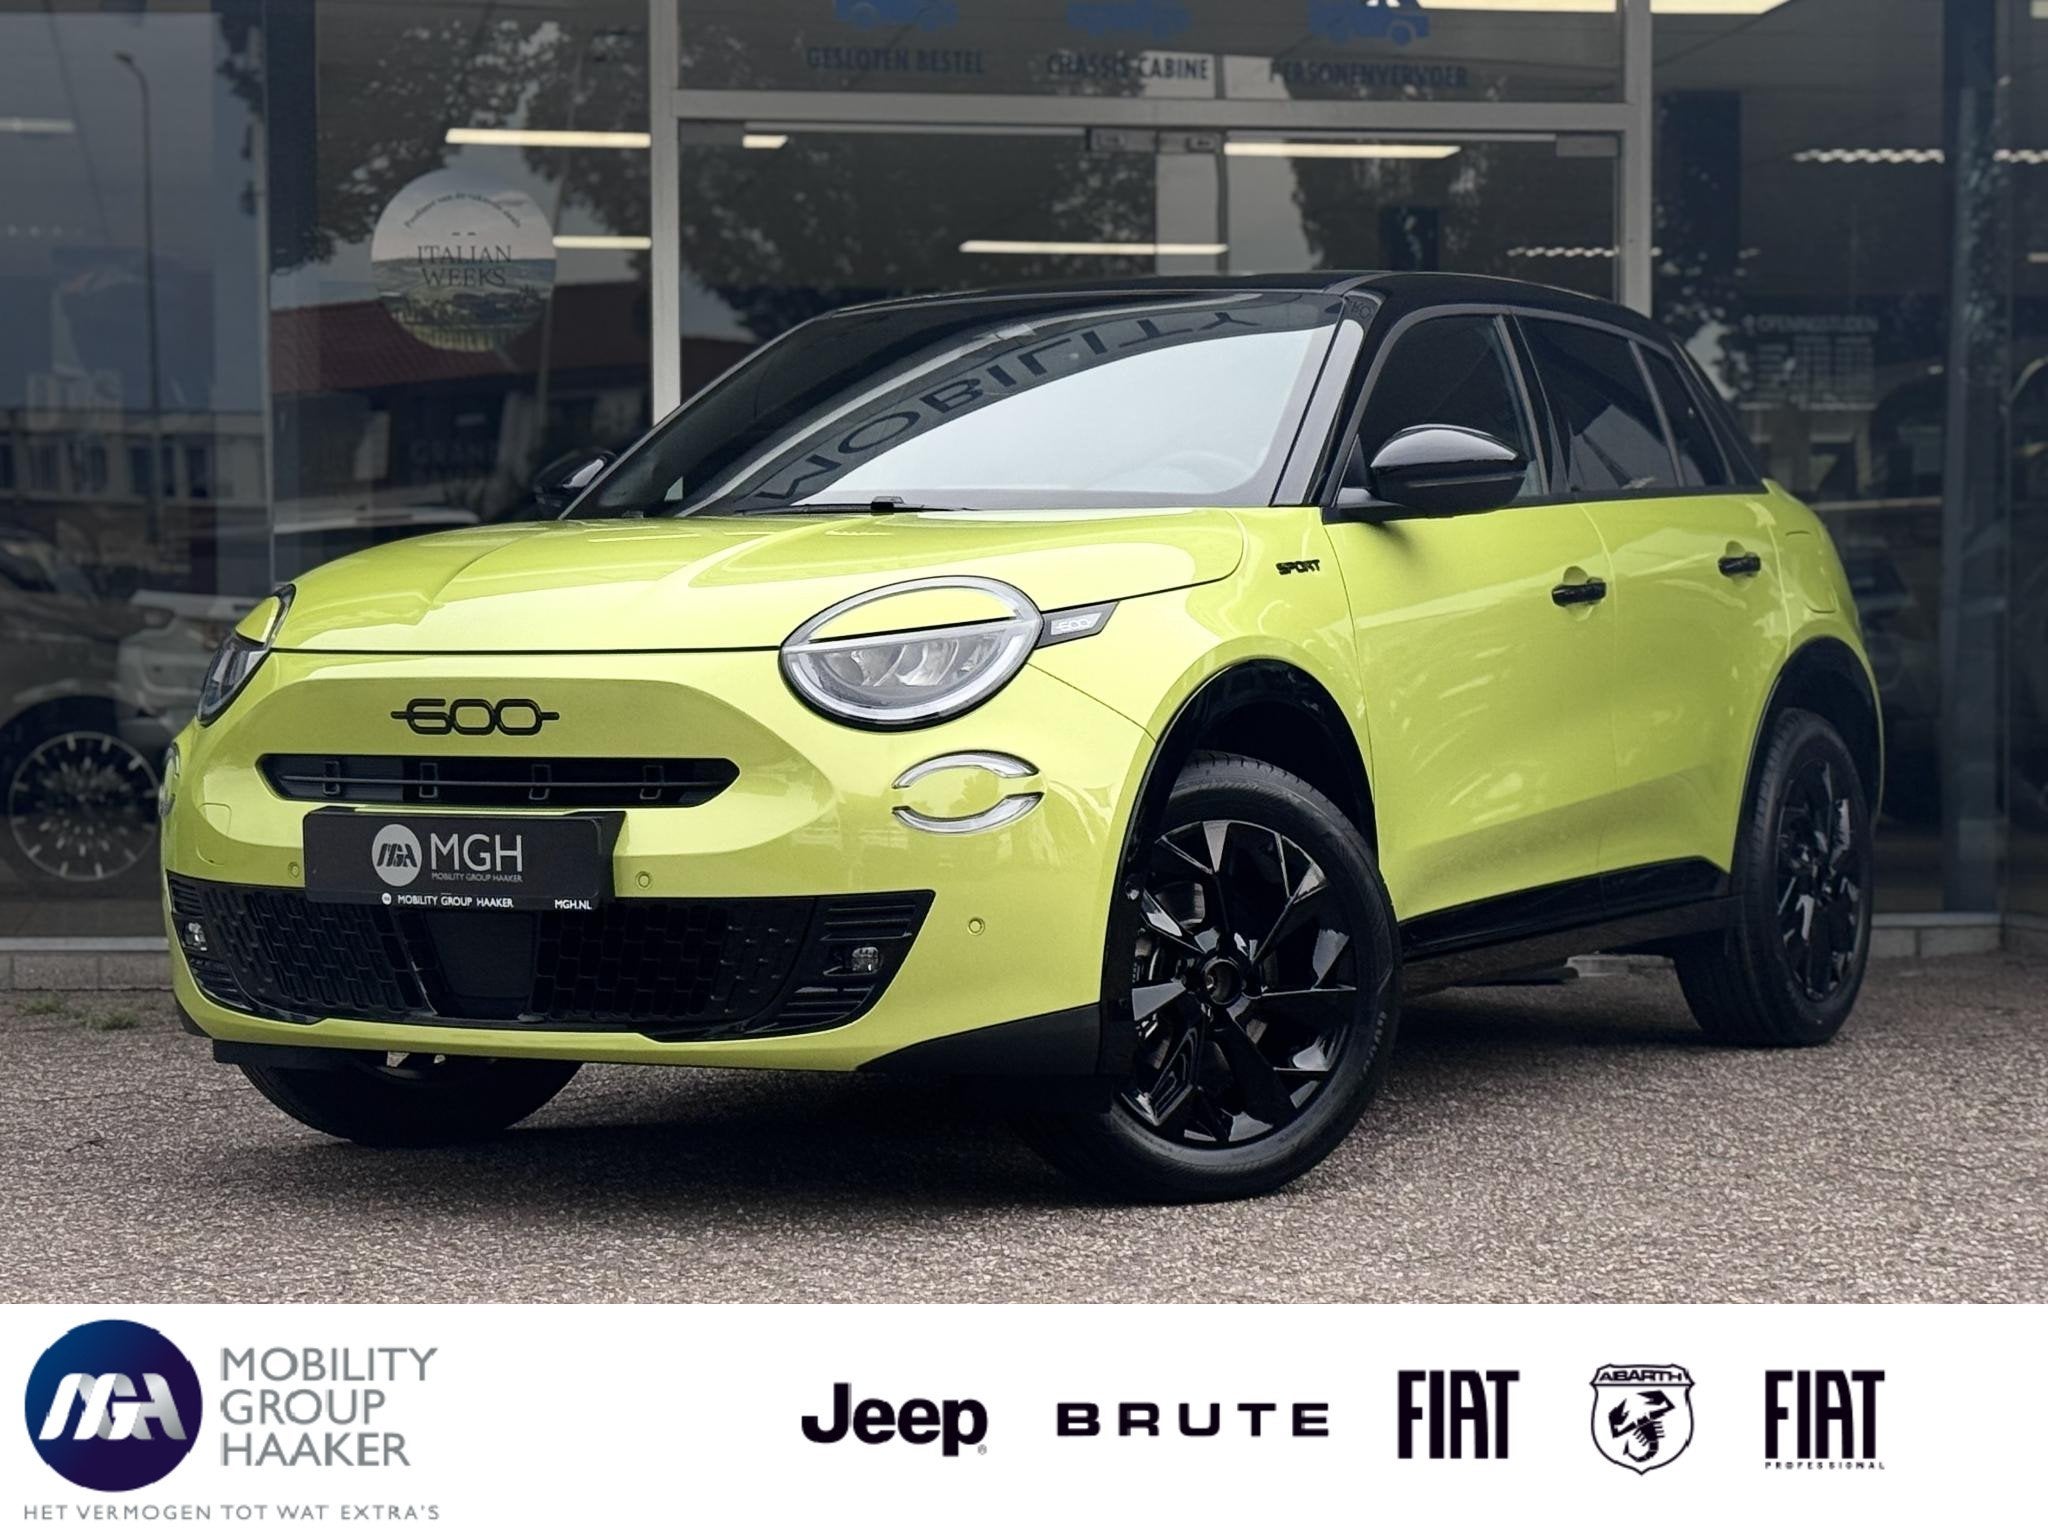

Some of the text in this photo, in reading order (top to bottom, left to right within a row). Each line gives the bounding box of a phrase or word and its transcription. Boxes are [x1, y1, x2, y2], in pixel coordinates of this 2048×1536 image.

[807, 47, 984, 74] GESLOTEN BESTEL
[416, 245, 512, 265] ITALIAN
[421, 267, 507, 288] WEEKS
[1275, 558, 1321, 576] SPORT
[391, 697, 560, 736] 600
[430, 833, 523, 873] MGH
[431, 871, 523, 884] MOBILITY GROUP HAAKER
[397, 894, 438, 906] MOBILITY
[440, 895, 472, 907] GROUP
[476, 897, 514, 909] HAAKER
[554, 899, 592, 910] MGH.NL
